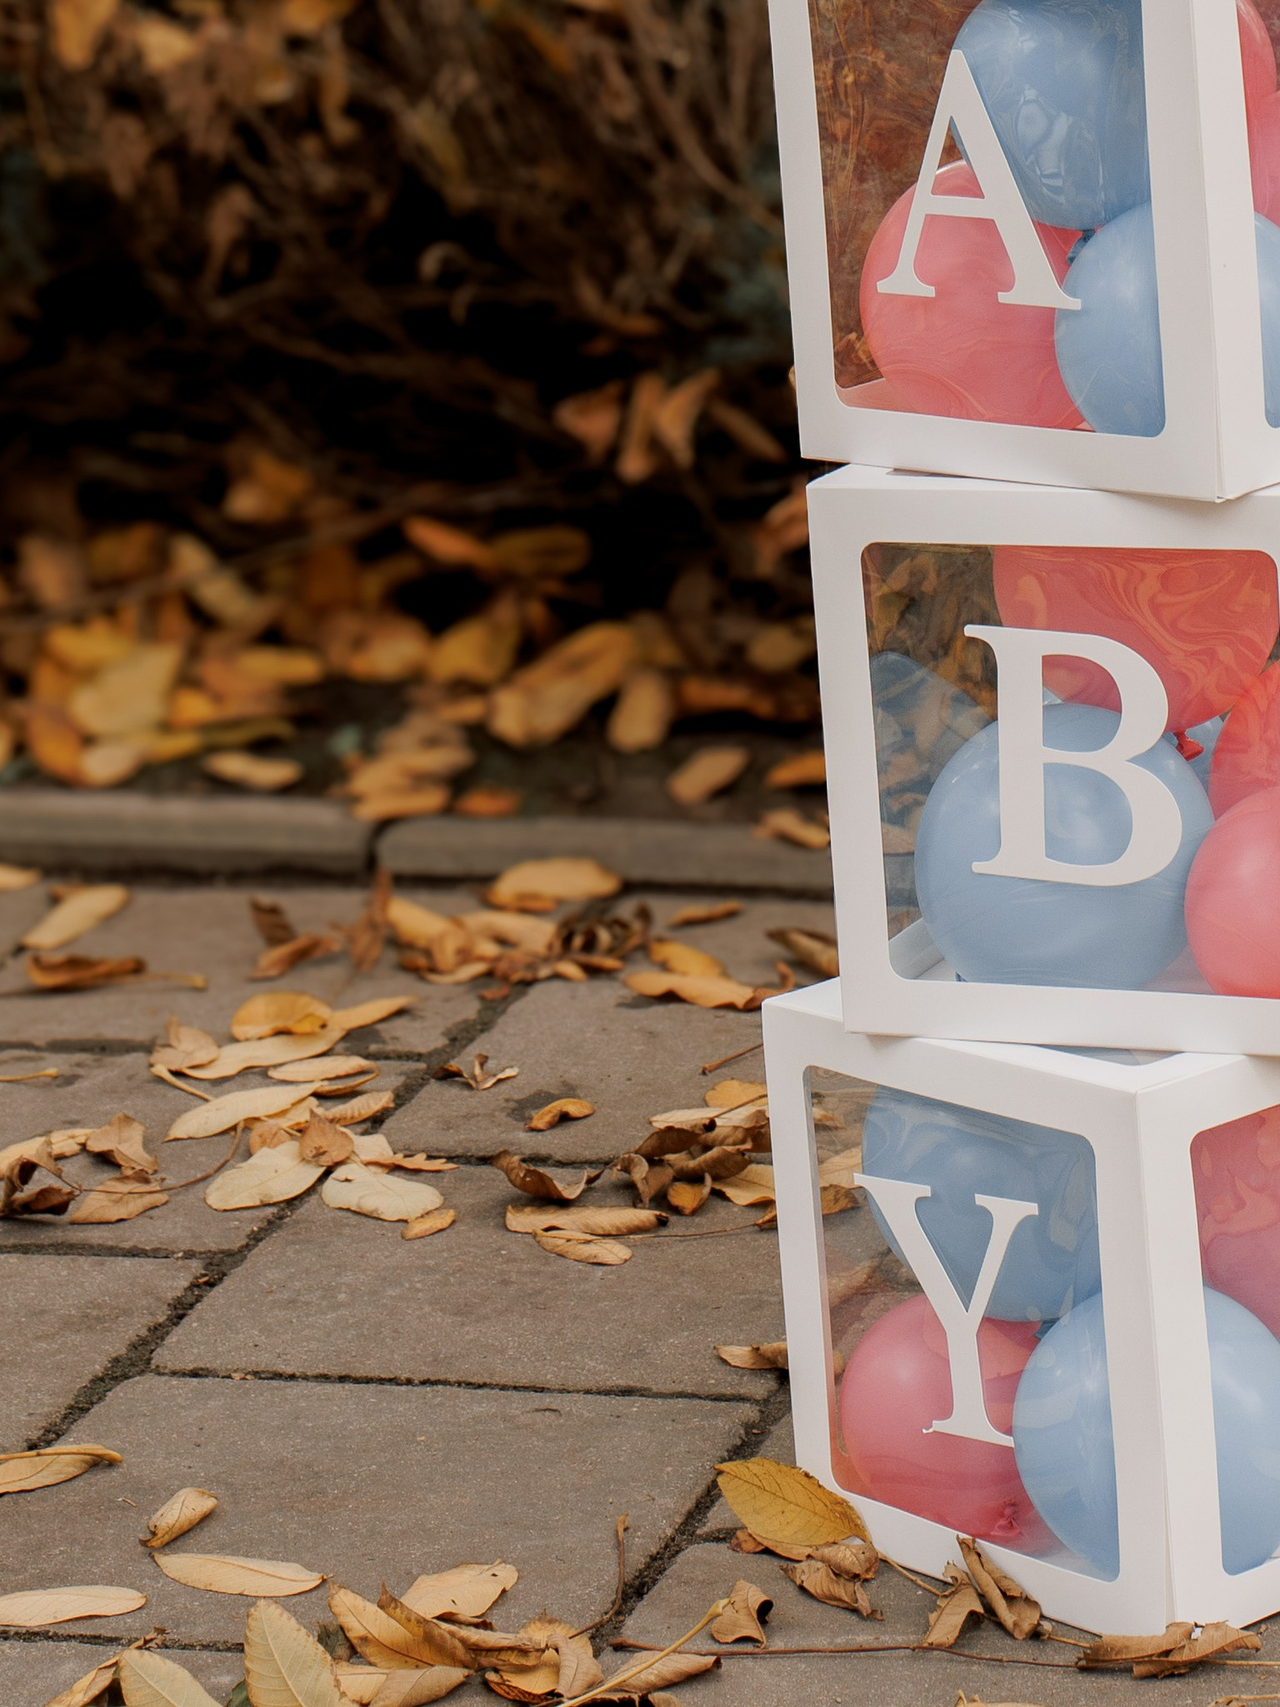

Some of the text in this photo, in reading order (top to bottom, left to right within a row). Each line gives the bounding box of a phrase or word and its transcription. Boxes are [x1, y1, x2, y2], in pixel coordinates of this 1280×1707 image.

[876, 49, 1081, 311] A
[963, 624, 1183, 887] B
[853, 1172, 1039, 1447] Y
